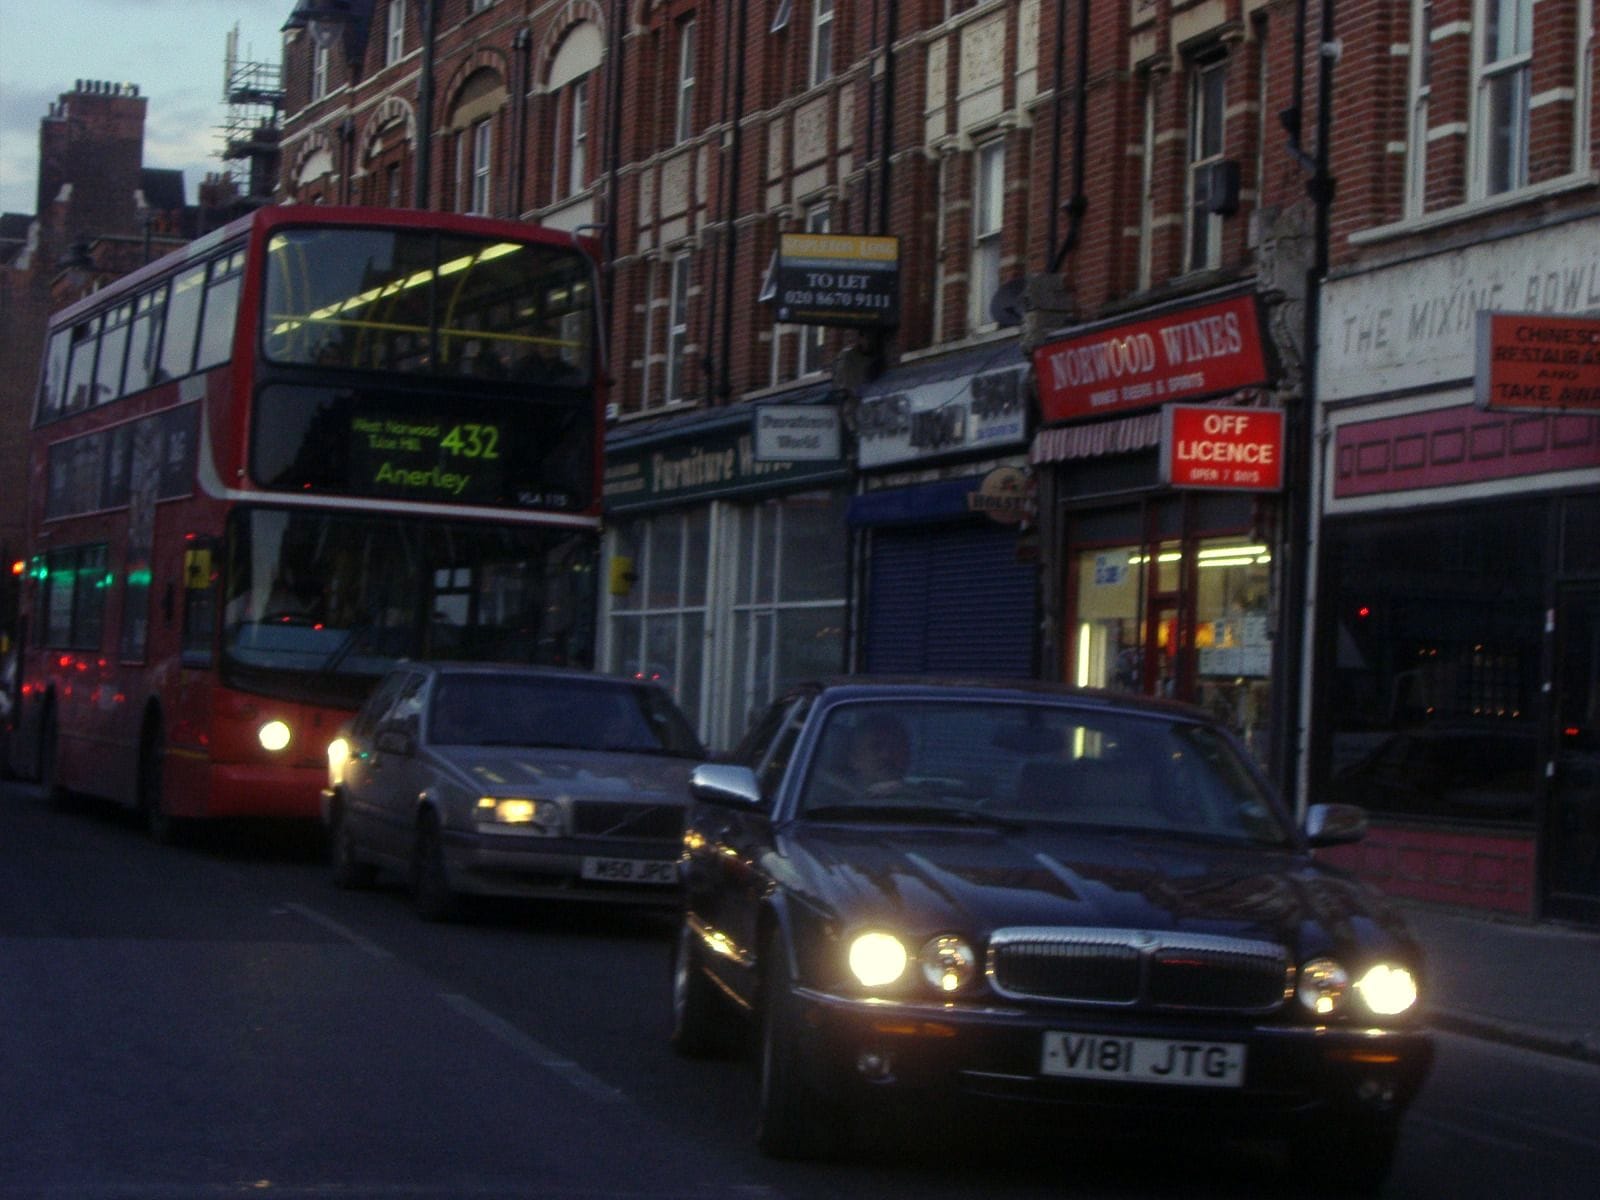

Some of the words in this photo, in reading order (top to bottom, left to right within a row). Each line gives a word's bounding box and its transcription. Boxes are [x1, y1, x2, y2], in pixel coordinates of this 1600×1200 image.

[806, 273, 834, 288] TO
[838, 274, 870, 290] LET
[784, 291, 813, 304] 020
[815, 292, 852, 306] 8670
[855, 293, 890, 308] 9111
[1345, 308, 1392, 354] THE
[1051, 333, 1155, 390] NORWOOD
[1159, 312, 1242, 367] WINES
[1495, 383, 1552, 401] TAKE
[440, 423, 499, 459] 432
[1203, 414, 1249, 435] OFF
[1177, 440, 1274, 464] LICENCE
[375, 461, 470, 495] Anerley
[652, 447, 735, 493] Furniture
[1152, 1045, 1227, 1078] JTG
